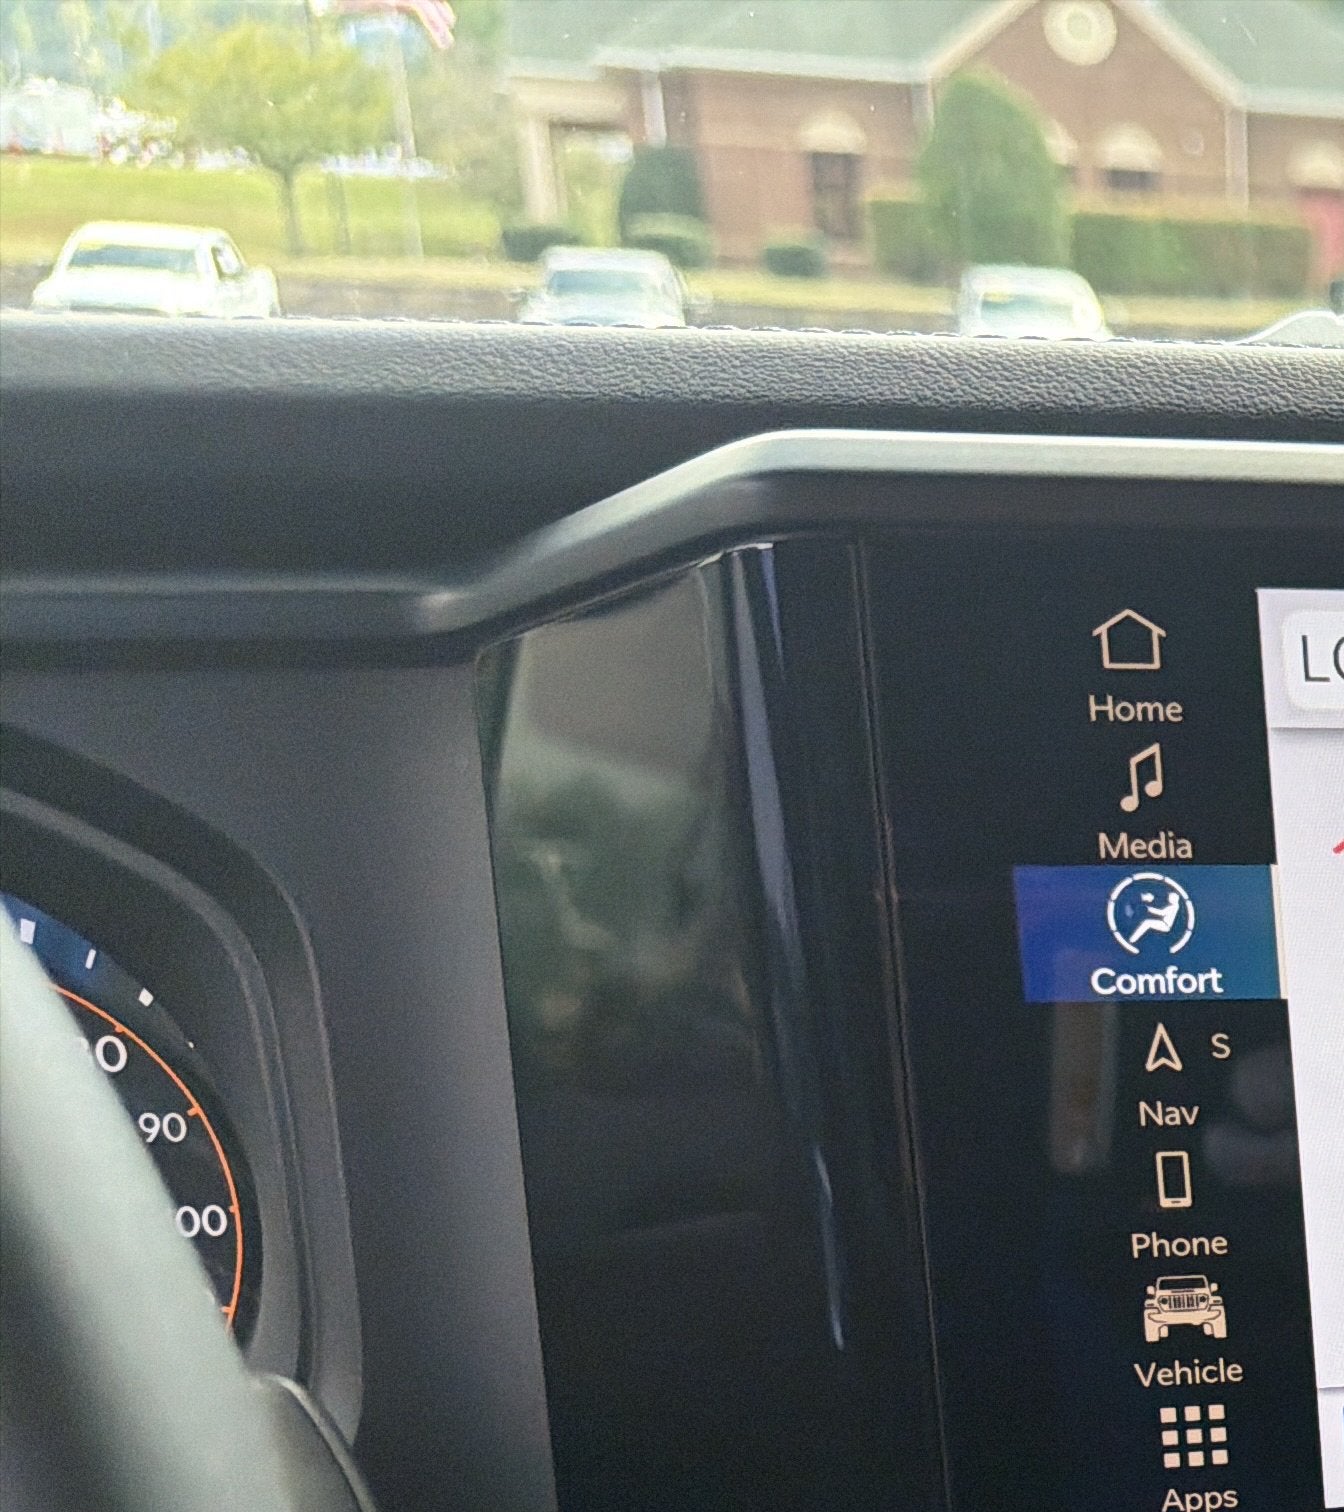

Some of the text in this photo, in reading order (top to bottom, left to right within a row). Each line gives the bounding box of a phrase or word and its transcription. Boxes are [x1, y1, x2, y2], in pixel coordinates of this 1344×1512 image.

[1088, 694, 1184, 724] Home
[1097, 831, 1193, 861] Media
[1091, 966, 1224, 998] Comfort
[1211, 1033, 1231, 1060] S
[137, 1111, 187, 1142] 90
[1139, 1099, 1200, 1128] Nav
[1131, 1230, 1229, 1259] Phone
[1134, 1358, 1244, 1389] Vehicle
